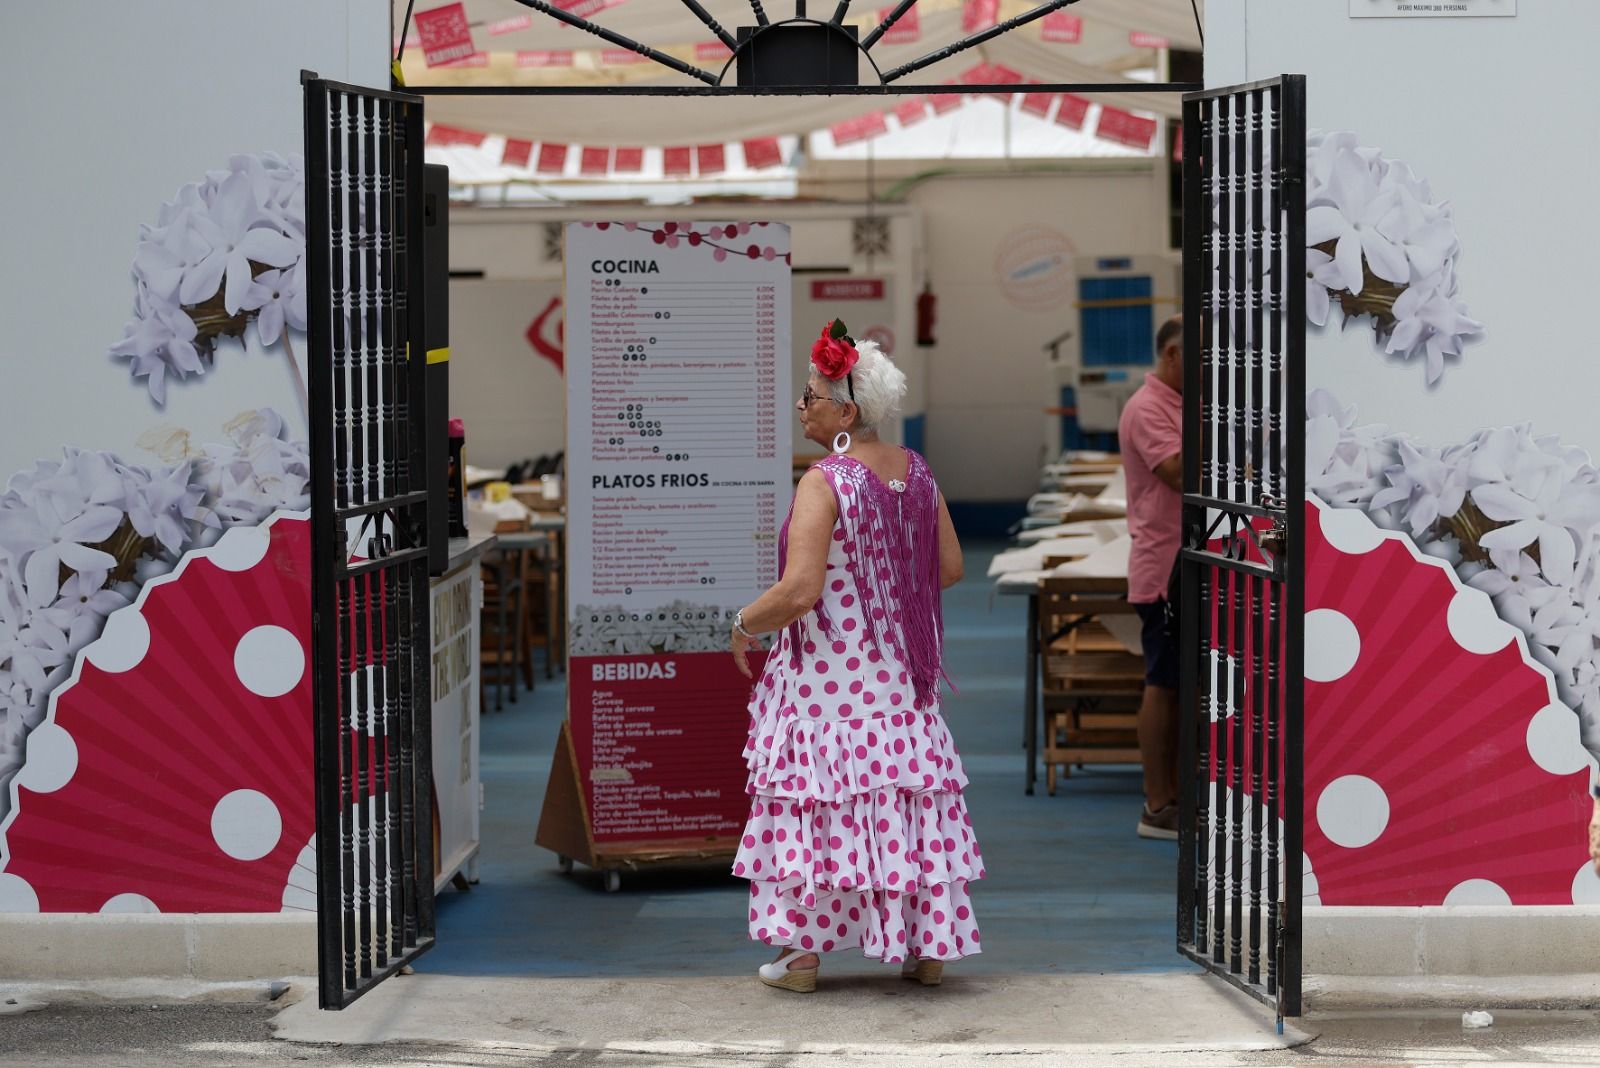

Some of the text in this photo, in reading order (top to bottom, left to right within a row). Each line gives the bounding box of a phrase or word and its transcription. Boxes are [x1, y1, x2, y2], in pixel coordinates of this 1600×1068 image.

[591, 260, 660, 274] COCINA
[592, 474, 656, 488] PLATOS
[661, 474, 709, 487] FRIOS
[592, 661, 676, 681] BEBIDAS
